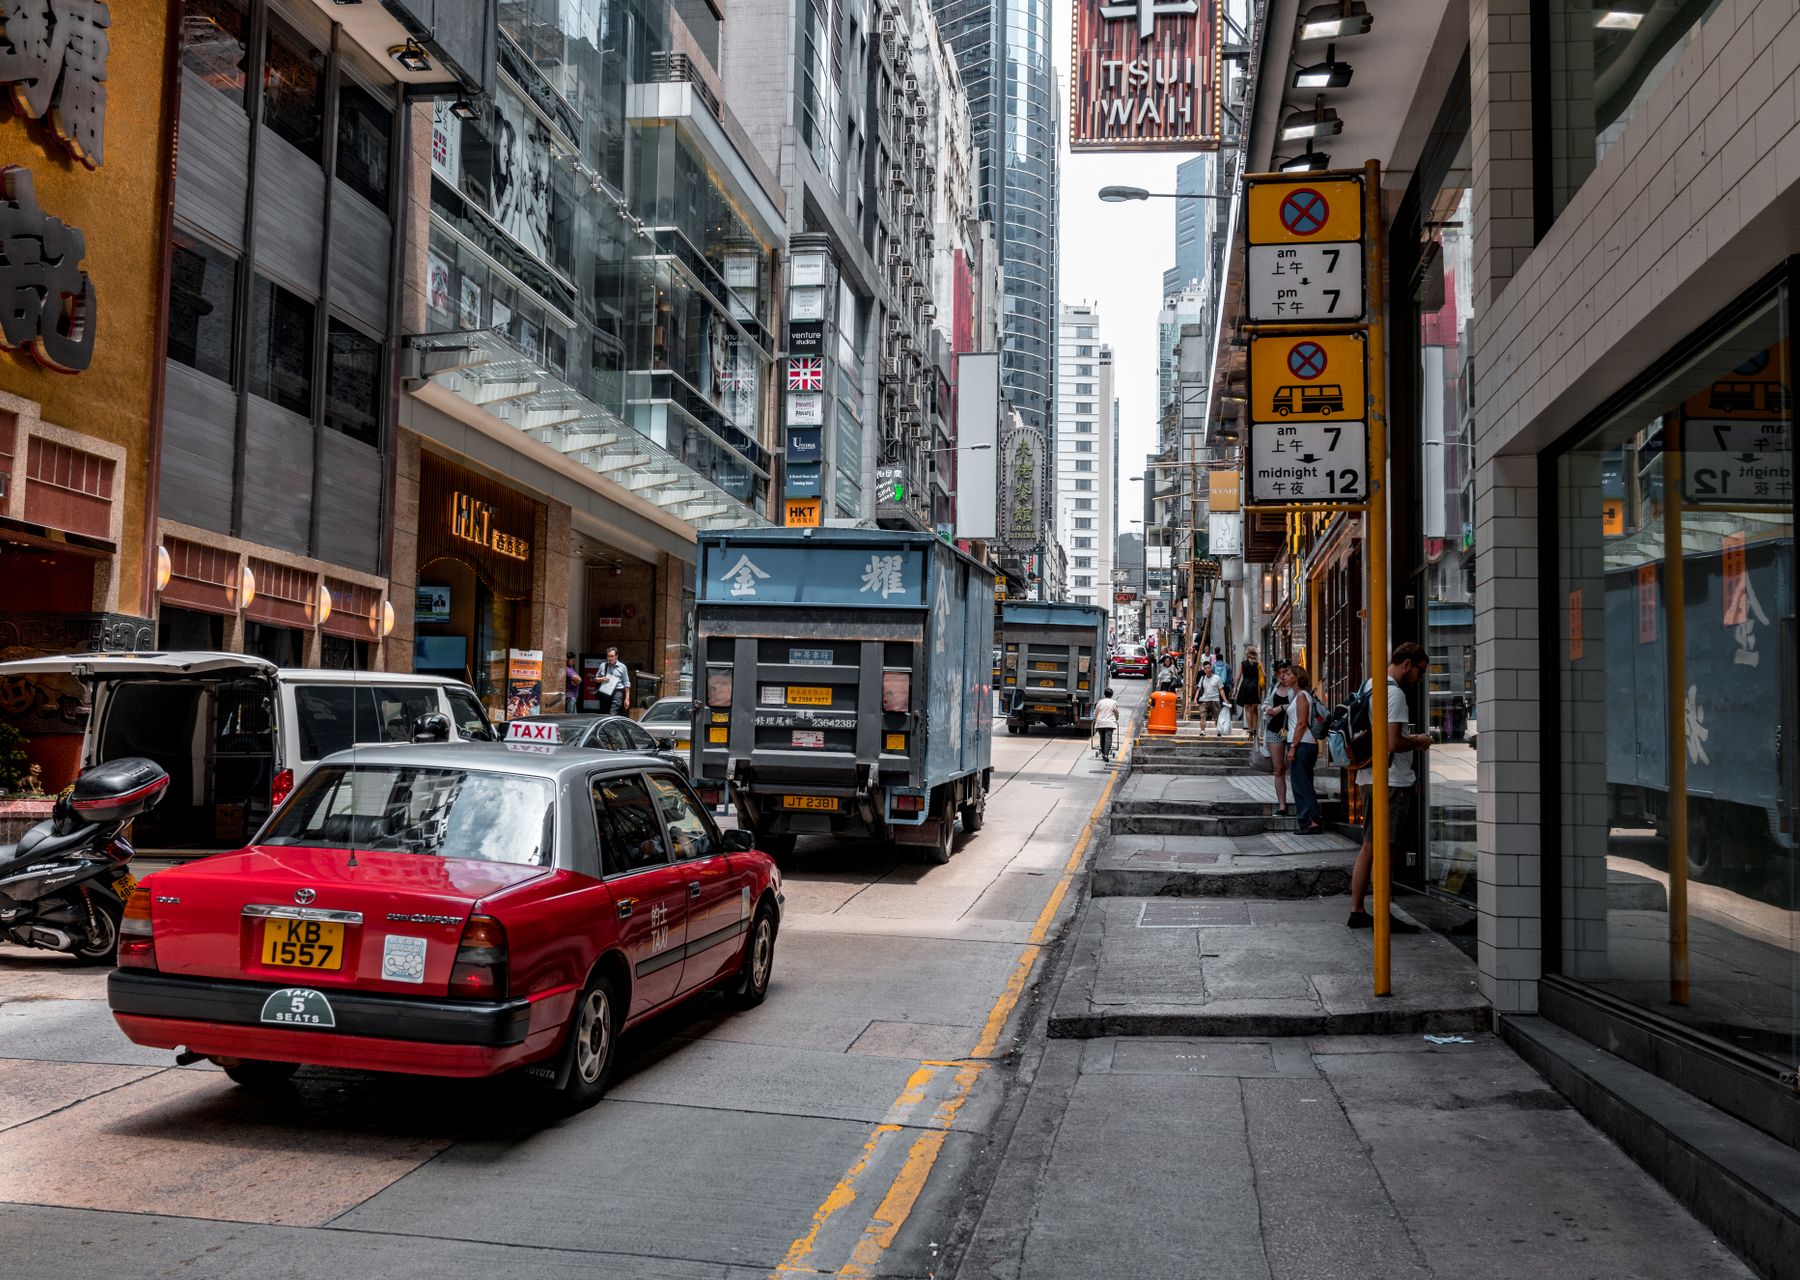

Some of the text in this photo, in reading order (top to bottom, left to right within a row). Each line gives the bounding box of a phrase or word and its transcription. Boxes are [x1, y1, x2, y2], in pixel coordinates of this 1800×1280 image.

[1103, 57, 1192, 86] TSUI
[1101, 96, 1191, 125] WAH
[1271, 261, 1304, 275] 上午
[1277, 249, 1340, 274] am 7
[1271, 301, 1304, 316] 下午
[1277, 289, 1341, 314] pm 7
[791, 331, 821, 340] venture
[1271, 439, 1304, 453] 上午
[1277, 427, 1342, 452] am 7
[1258, 467, 1359, 494] midnight 12
[1272, 482, 1304, 495] 午夜
[790, 506, 815, 517] HKT
[511, 723, 553, 740] TAXI
[811, 719, 858, 728] 23642387
[788, 797, 834, 809] JT 2381
[411, 914, 464, 926] COMFORT
[651, 901, 668, 928] 的士
[287, 919, 321, 944] KB
[651, 925, 669, 953] TAXI
[271, 940, 334, 967] 1557
[285, 989, 316, 999] TAXI
[290, 997, 305, 1013] 5
[275, 1012, 320, 1024] SEATS
